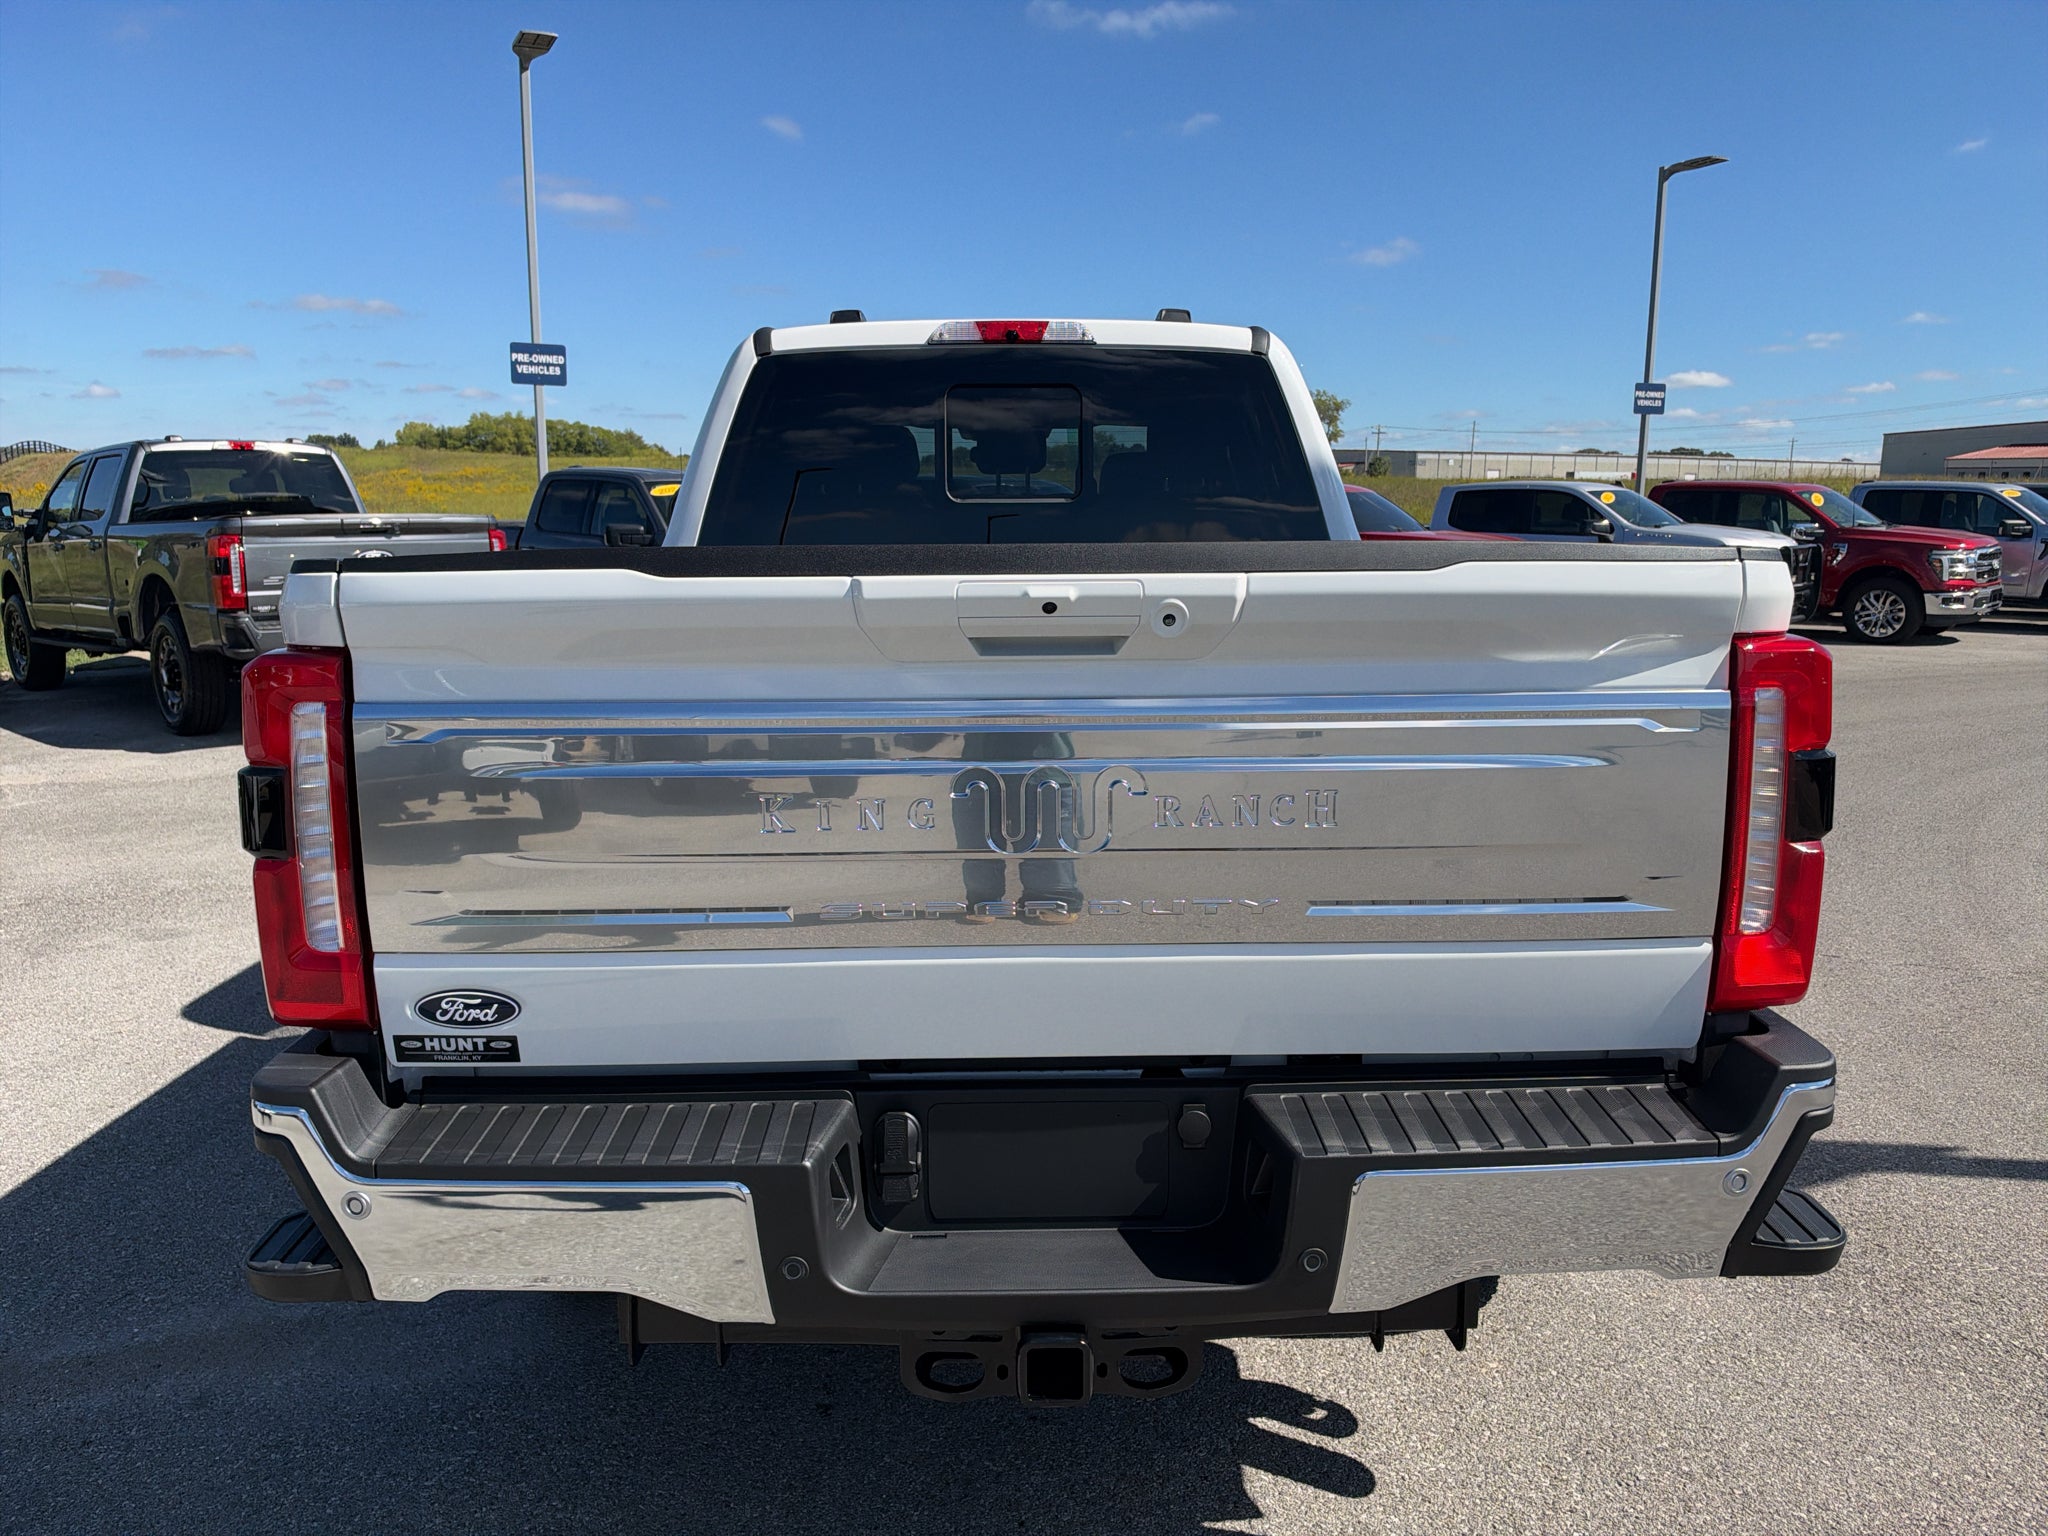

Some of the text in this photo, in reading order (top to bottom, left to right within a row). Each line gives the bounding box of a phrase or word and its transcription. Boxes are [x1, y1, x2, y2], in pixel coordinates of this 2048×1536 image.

[511, 353, 564, 364] PRE-OWNED
[516, 364, 561, 375] VEHICLES
[758, 789, 1340, 834] KING RANCH
[819, 898, 1280, 921] SUPER DUTY
[435, 996, 498, 1022] Ford
[424, 1038, 487, 1051] HUNT
[433, 1054, 482, 1062] FRANKLIN, KY
